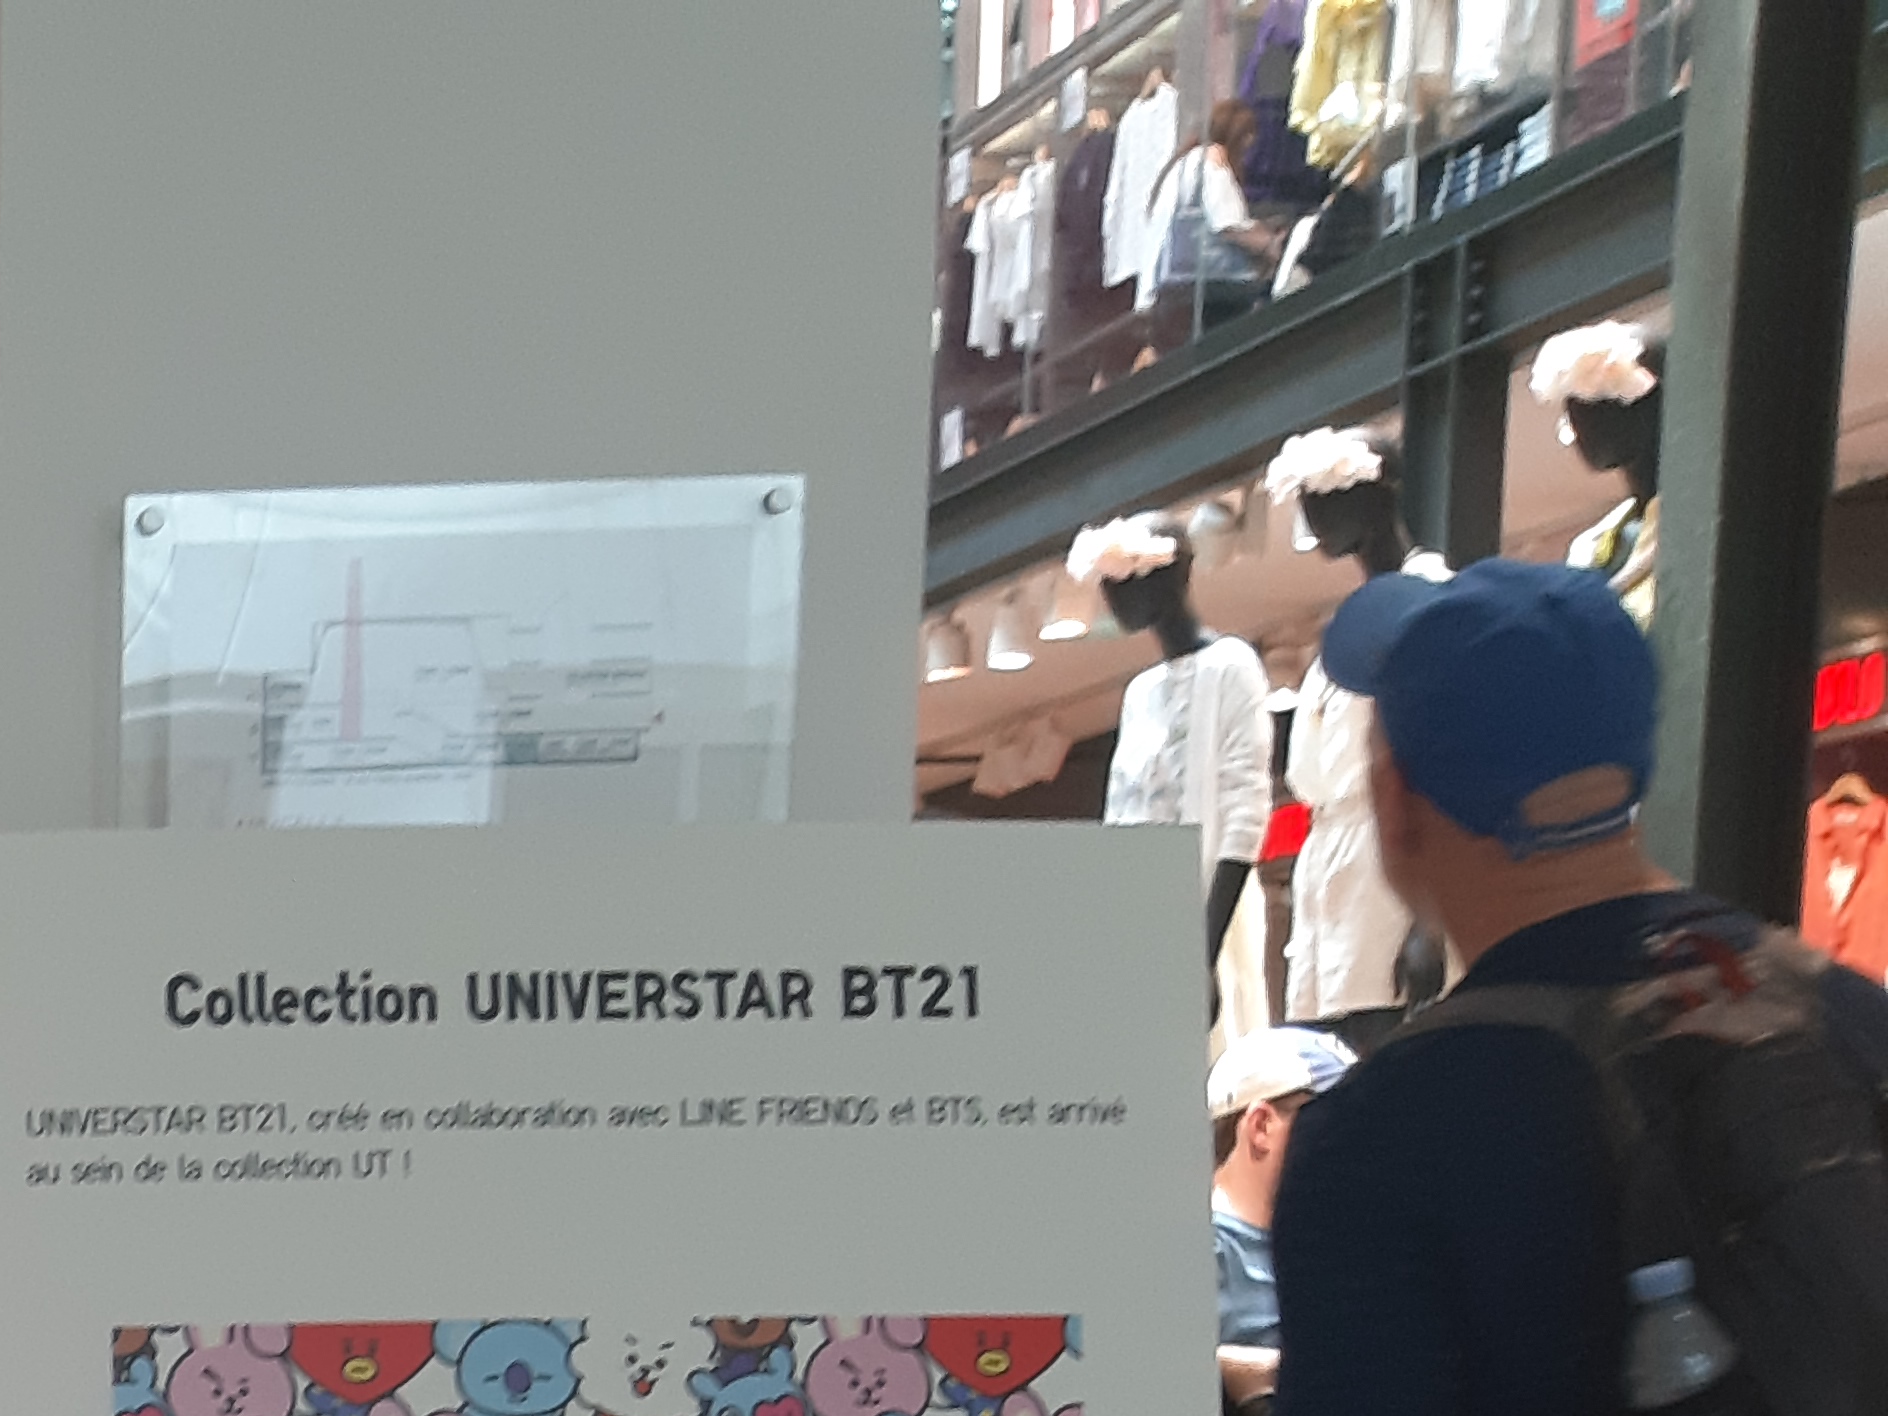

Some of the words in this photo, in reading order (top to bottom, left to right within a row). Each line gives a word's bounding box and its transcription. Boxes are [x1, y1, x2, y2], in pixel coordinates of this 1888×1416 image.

[165, 968, 438, 1029] Collection
[466, 968, 814, 1024] UNIVERSTAR
[840, 964, 981, 1020] BT21
[24, 1105, 205, 1137] UNIVERSTAR
[216, 1103, 297, 1136] BT21,
[307, 1102, 370, 1132] créé
[380, 1107, 414, 1130] en
[424, 1101, 597, 1131] collaboration
[607, 1104, 670, 1127] avec
[680, 1098, 747, 1127] LINE
[757, 1096, 879, 1127] FRIENDS
[888, 1097, 915, 1126] et
[927, 1096, 989, 1128] BTS,
[997, 1097, 1037, 1126] est
[1047, 1094, 1128, 1125] arrivé
[24, 1163, 61, 1186] au
[71, 1155, 124, 1184] sein
[133, 1155, 168, 1183] de
[178, 1154, 203, 1181] la
[213, 1151, 343, 1181] collection
[352, 1149, 393, 1179] UT
